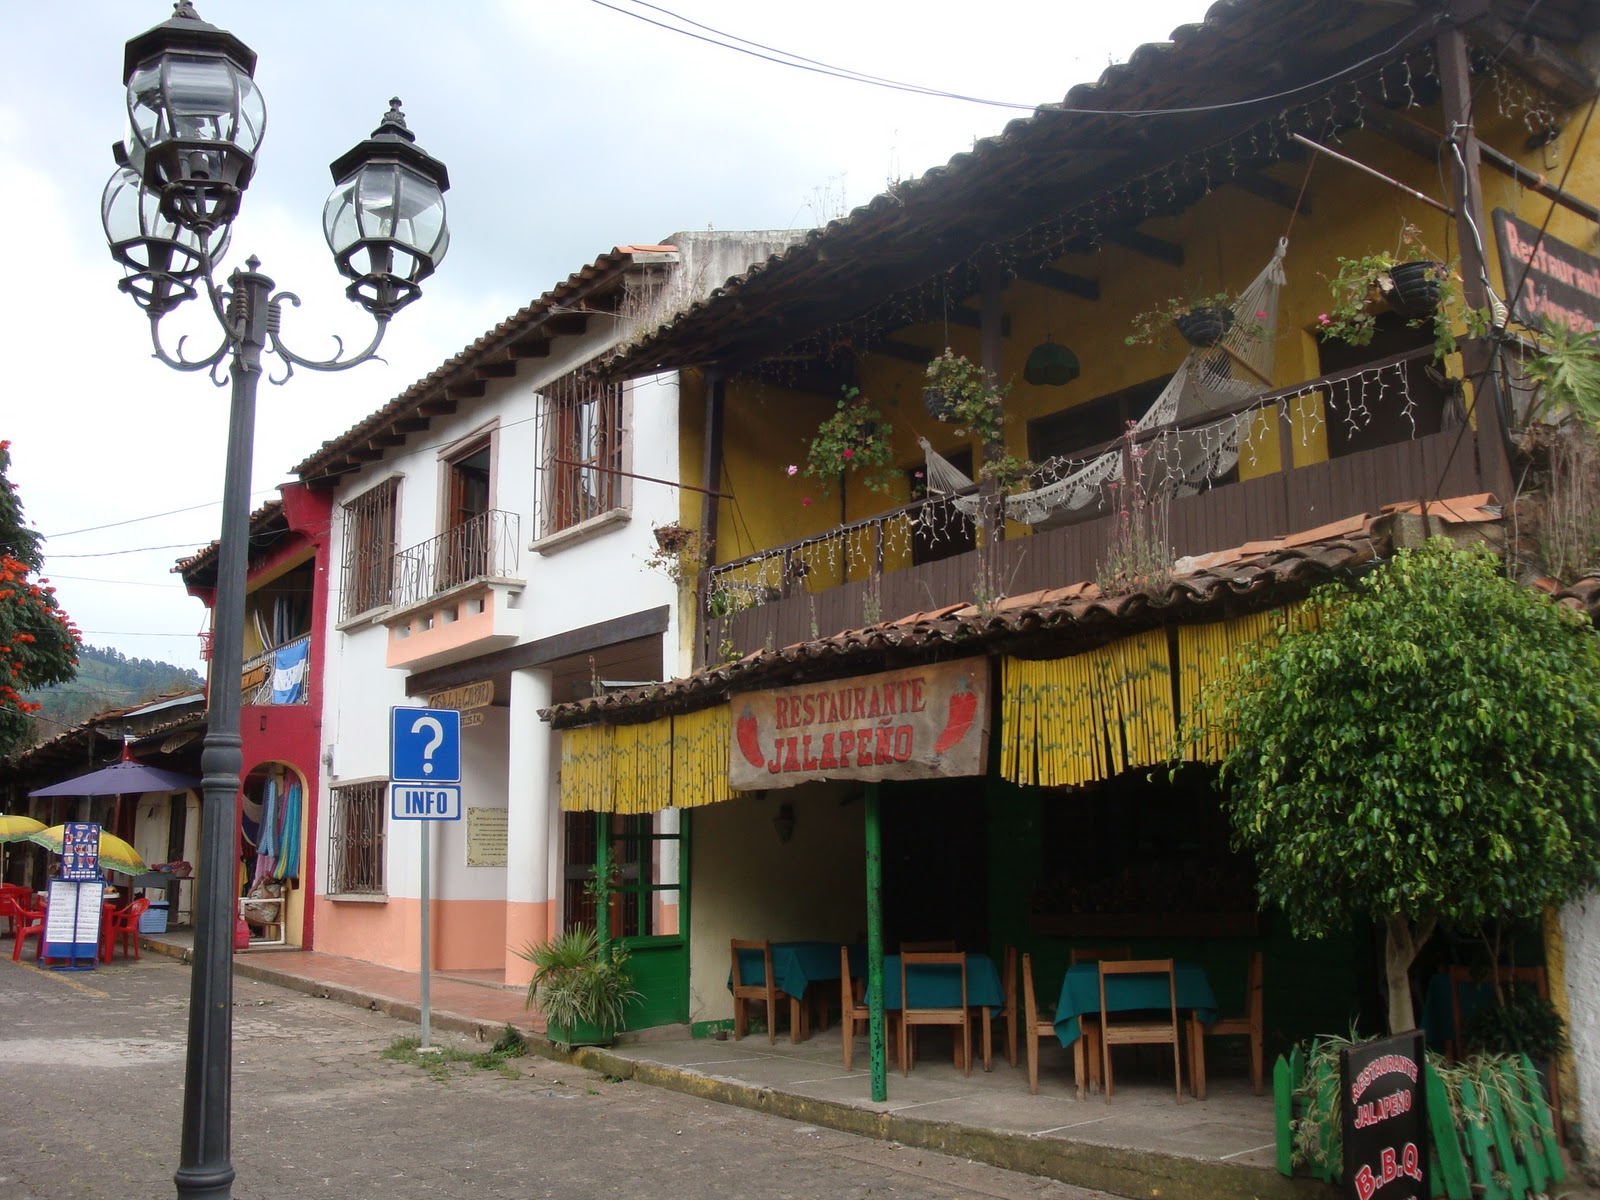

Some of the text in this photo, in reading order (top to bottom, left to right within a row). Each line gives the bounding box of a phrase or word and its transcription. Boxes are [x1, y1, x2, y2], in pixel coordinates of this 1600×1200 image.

[776, 677, 926, 729] RESTAURANTE
[768, 717, 913, 774] JALAPEÑO
[406, 791, 447, 814] INFO
[1352, 1055, 1418, 1104] RESTAURANTE
